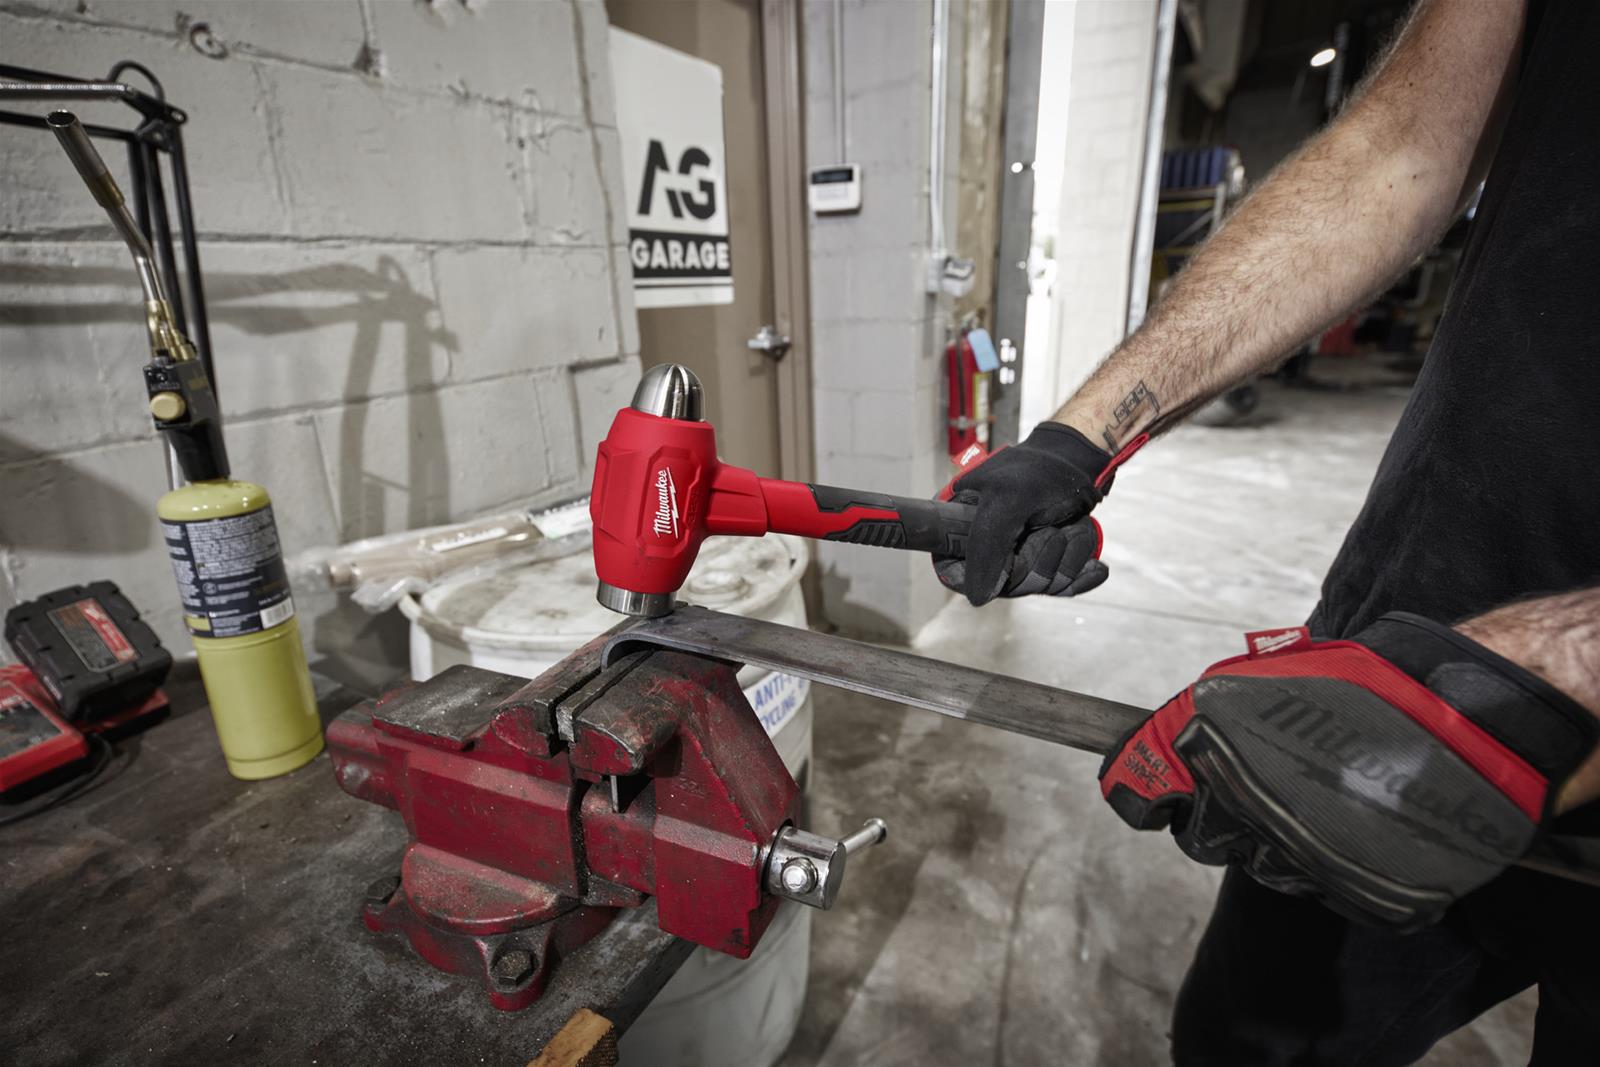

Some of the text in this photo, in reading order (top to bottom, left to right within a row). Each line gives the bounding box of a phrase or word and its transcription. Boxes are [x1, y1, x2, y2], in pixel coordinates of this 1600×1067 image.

[637, 139, 716, 220] AG
[631, 238, 730, 270] GARAGE
[653, 469, 673, 538] Milwaukee
[1258, 694, 1519, 857] Milwaukee
